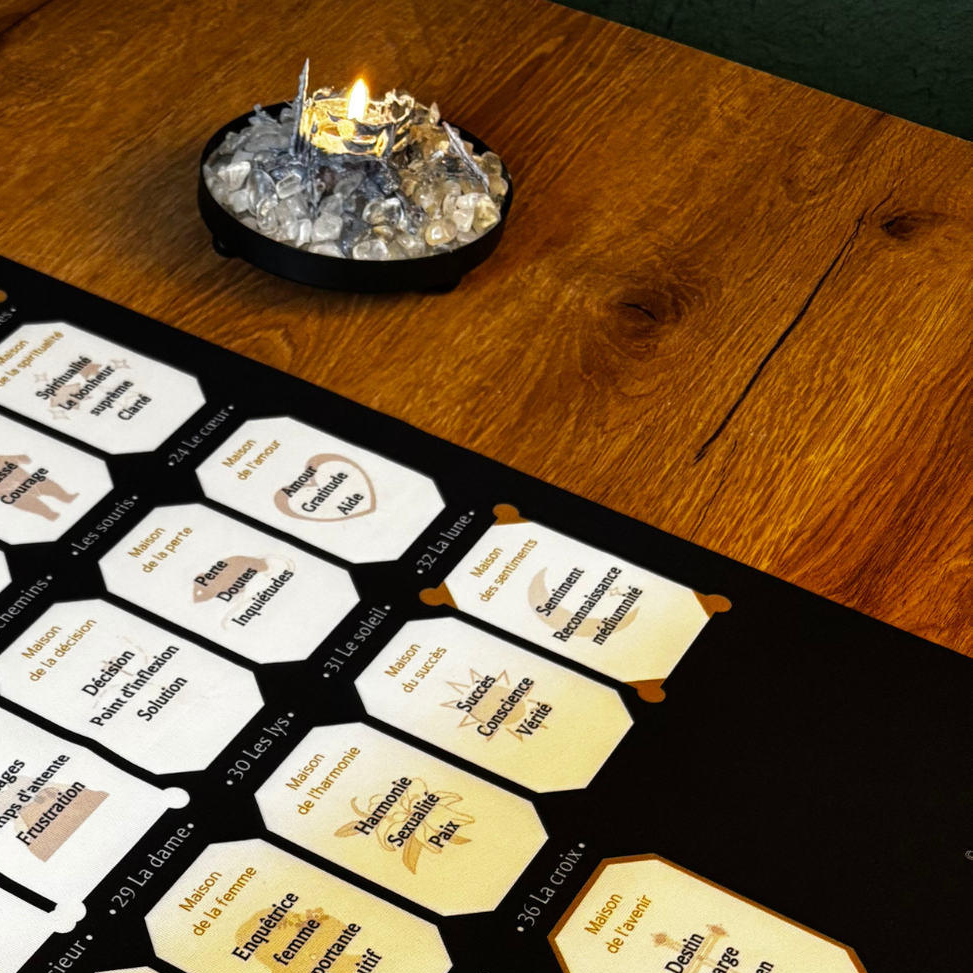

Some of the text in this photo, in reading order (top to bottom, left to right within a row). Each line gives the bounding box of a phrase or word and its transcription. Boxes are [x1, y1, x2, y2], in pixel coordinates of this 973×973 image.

[35, 355, 93, 401] Spiritualité
[57, 364, 116, 411] Le bonheur
[89, 379, 135, 416] suprême
[116, 393, 152, 421] Clarté
[0, 466, 50, 506] Courage
[280, 464, 318, 499] Amour
[300, 471, 349, 513] Gratitude
[336, 492, 365, 516] Aide
[415, 514, 473, 571] 32 La lune
[193, 559, 229, 588] Perte
[215, 566, 259, 603] Doutes
[534, 567, 586, 618] Sentiment
[230, 568, 295, 628] Inquiétudes
[551, 566, 623, 643] Reconnaissance
[591, 585, 644, 647] médiumnité
[80, 650, 136, 698] Décision
[88, 645, 181, 727] Point d'inflexion
[136, 676, 189, 723] Solution
[352, 776, 413, 837] Harmonie
[386, 790, 441, 849] Sexualité
[427, 819, 461, 849] Paix
[516, 848, 584, 928] 36 La croix
